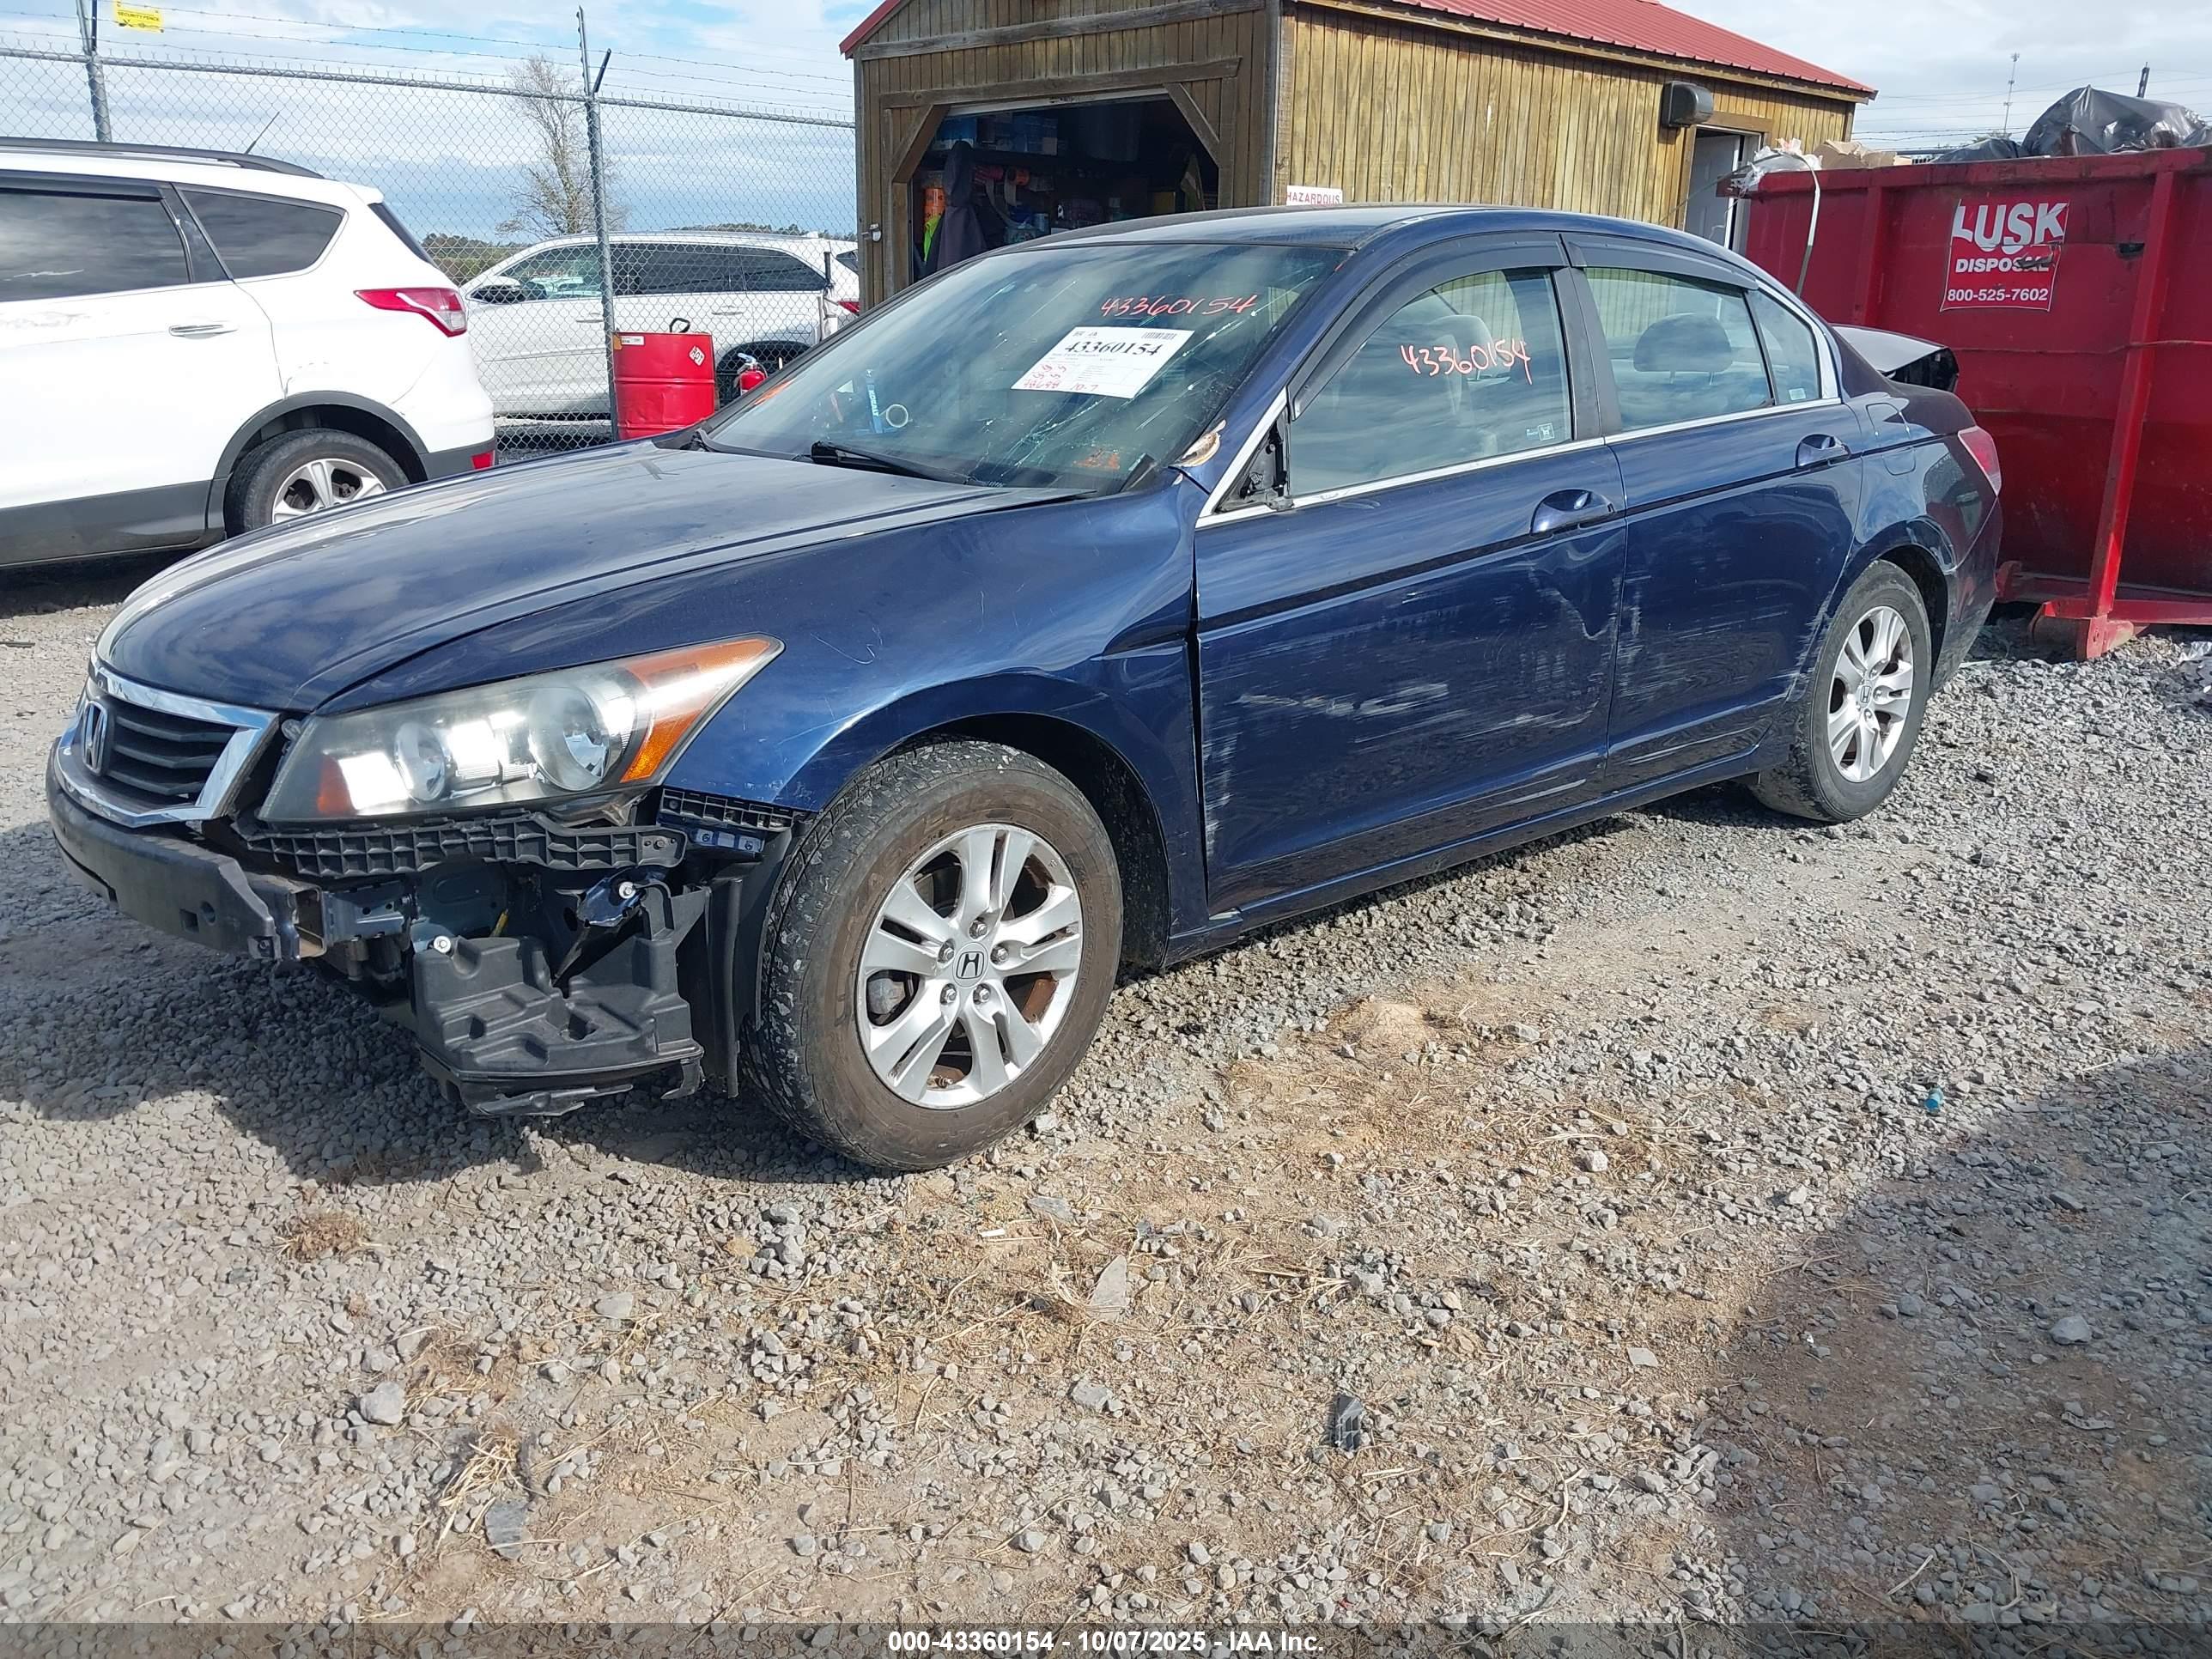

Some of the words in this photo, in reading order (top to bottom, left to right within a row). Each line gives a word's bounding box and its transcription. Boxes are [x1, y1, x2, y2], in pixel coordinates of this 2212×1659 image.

[1286, 191, 1340, 204] HAZARDOUS
[1952, 203, 2069, 254] LUSK
[1947, 289, 2049, 301] 800-525-7602
[1101, 295, 1258, 317] 43360154
[1065, 341, 1164, 356] 43360154
[1401, 338, 1533, 385] 43360154
